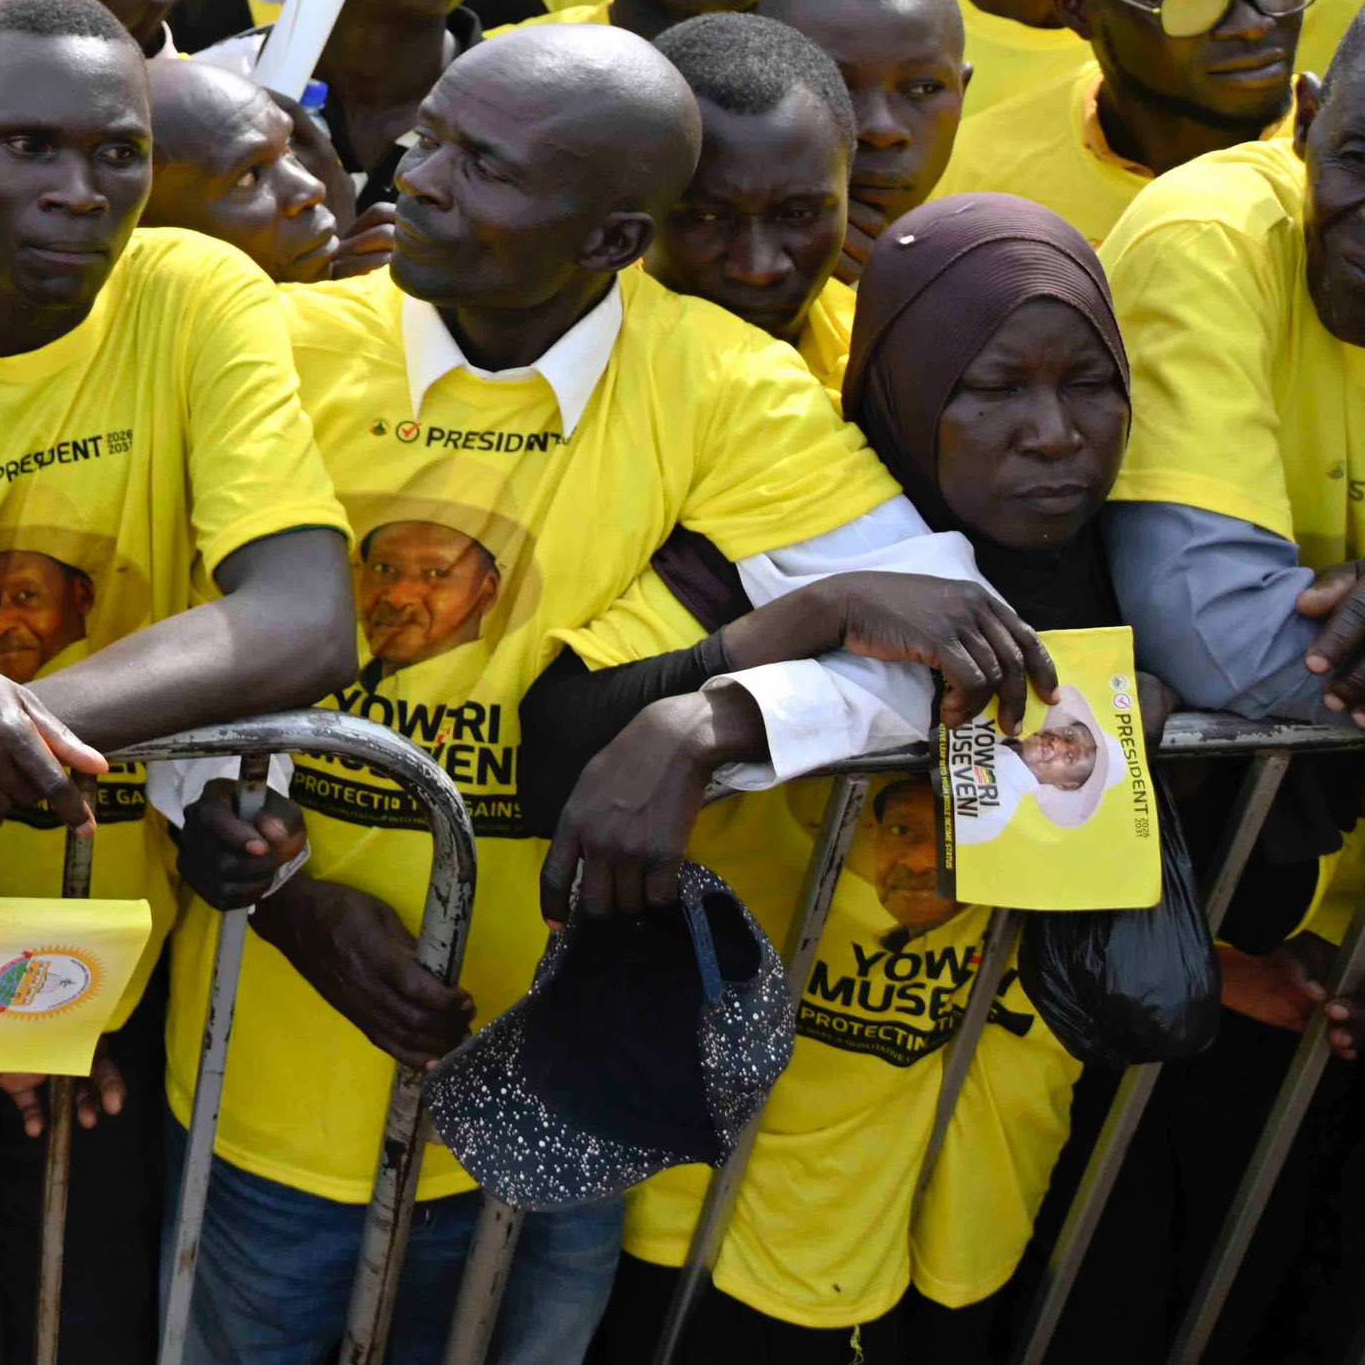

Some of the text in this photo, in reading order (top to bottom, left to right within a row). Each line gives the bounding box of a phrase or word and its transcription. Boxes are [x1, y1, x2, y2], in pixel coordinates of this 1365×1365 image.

[951, 723, 979, 818] USEVENI
[1115, 714, 1149, 815] PRESIDENT
[945, 843, 953, 869] STATUS
[800, 1007, 927, 1052] PROTECTIN
